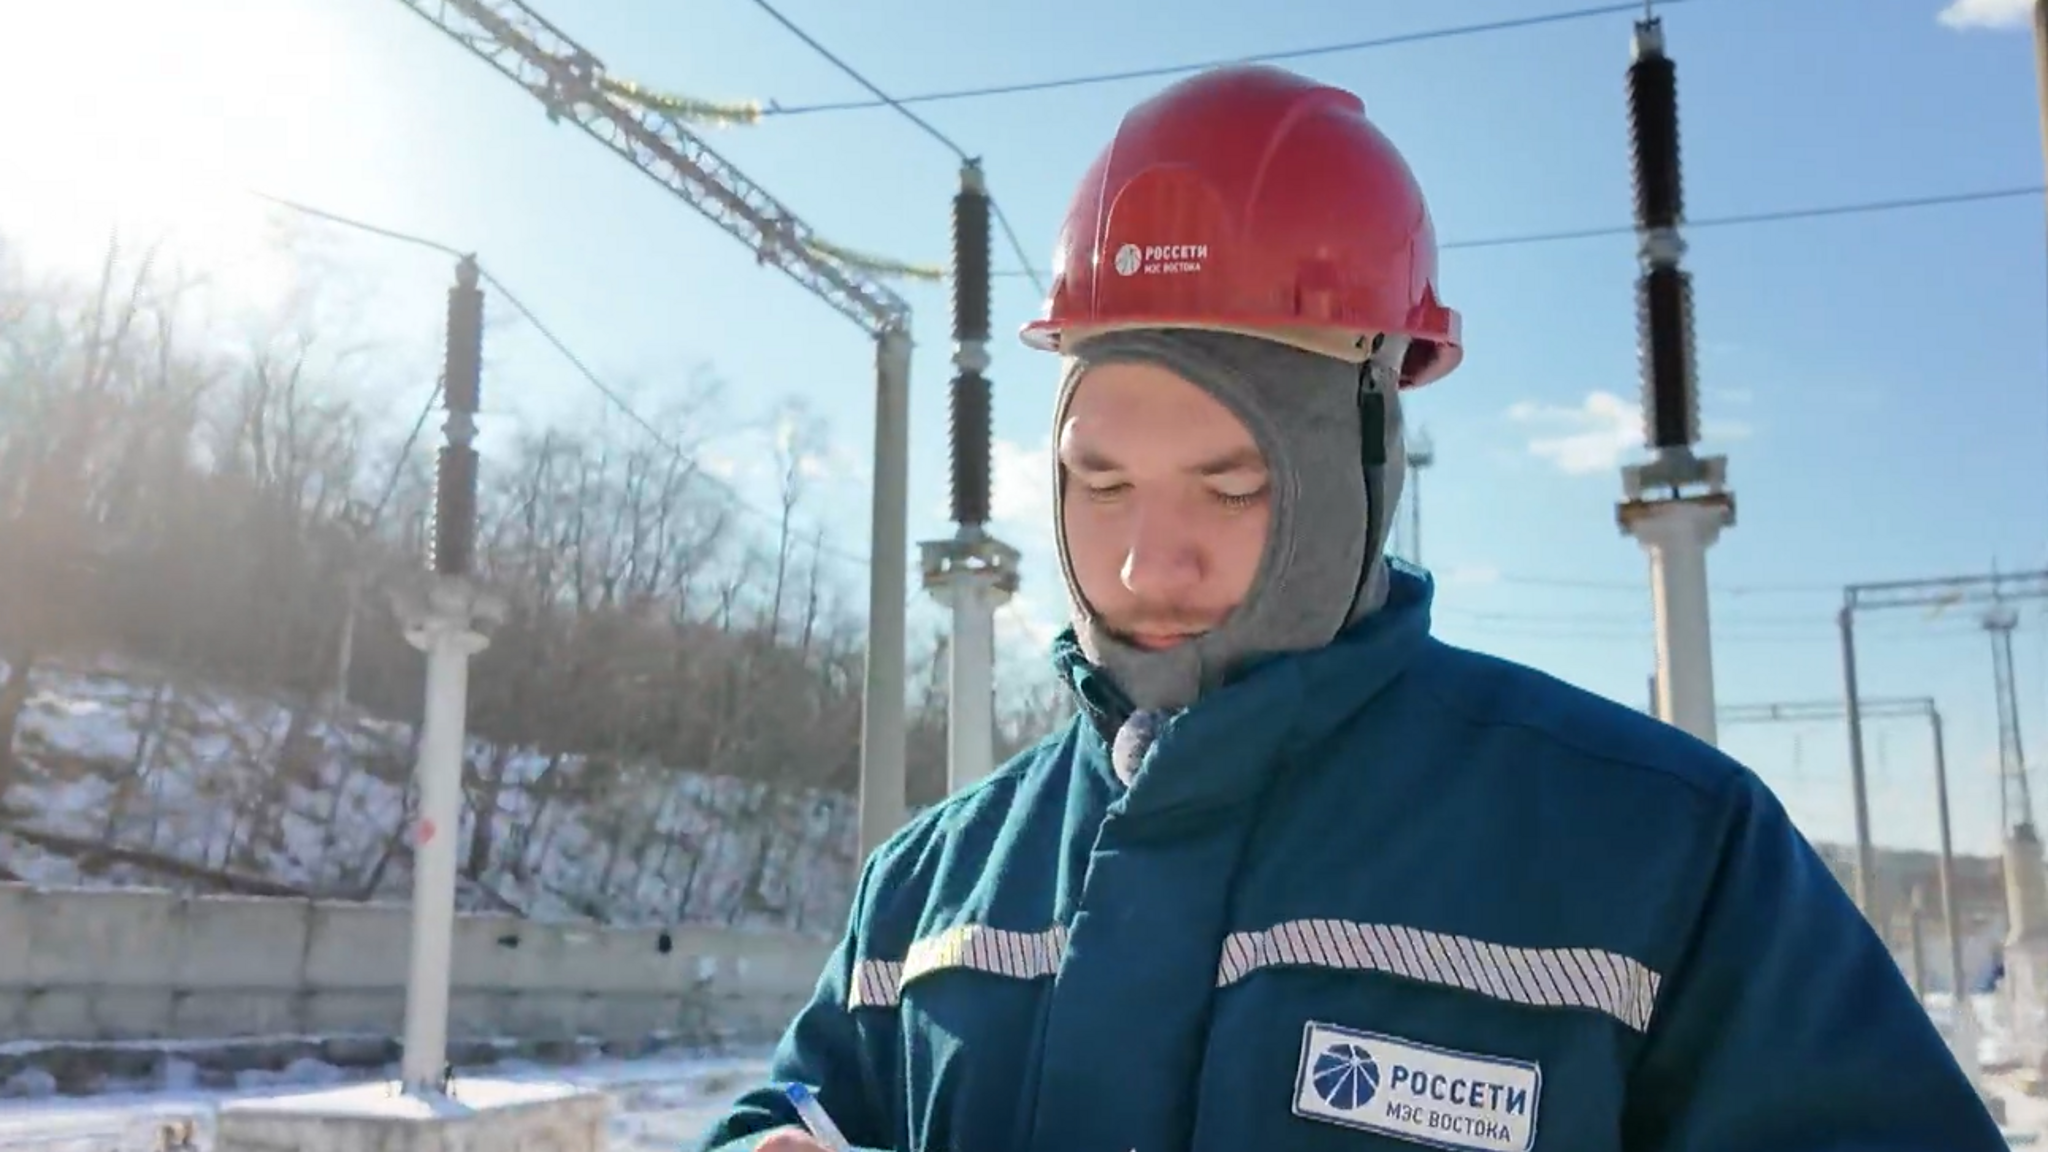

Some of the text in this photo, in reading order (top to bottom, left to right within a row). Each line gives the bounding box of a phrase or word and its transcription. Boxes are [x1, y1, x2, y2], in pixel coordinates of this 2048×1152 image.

[1145, 245, 1208, 261] РОССЕТИ
[1163, 262, 1201, 273] ВОСТОКА
[1390, 1065, 1527, 1116] РОССЕТИ
[1386, 1101, 1511, 1143] МЭС ВОСТОКА
